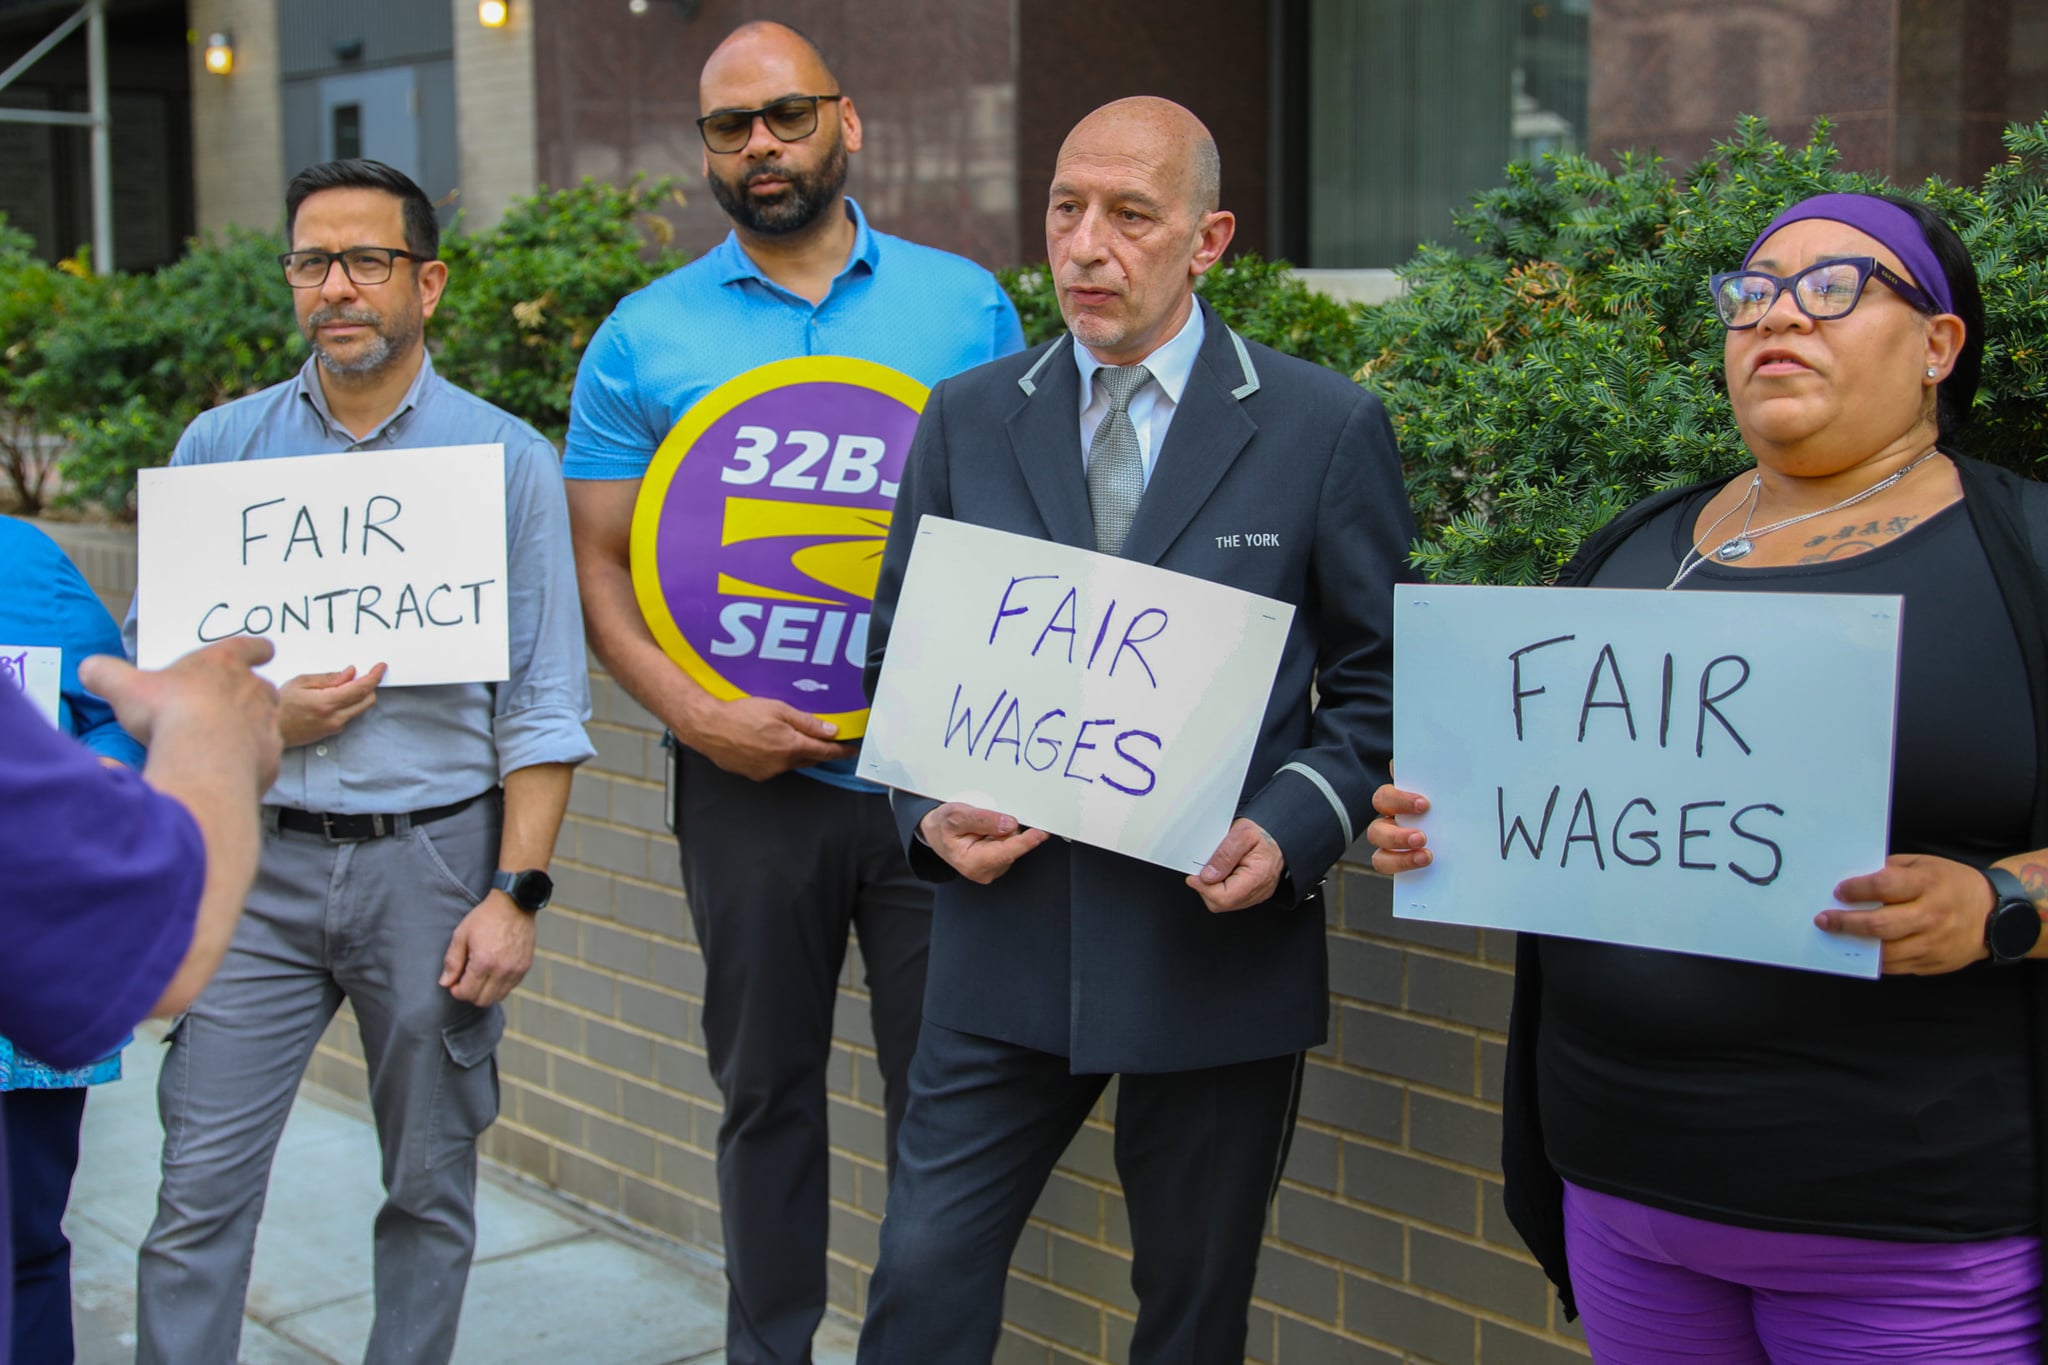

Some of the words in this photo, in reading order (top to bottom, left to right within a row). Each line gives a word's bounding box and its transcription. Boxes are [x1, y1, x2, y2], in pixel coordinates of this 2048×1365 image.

[241, 495, 405, 565] FAIR
[1215, 534, 1241, 549] THE
[1244, 533, 1280, 547] YORK
[198, 579, 496, 642] CONTRACT
[989, 575, 1169, 688] FAIR
[944, 683, 1163, 798] WAGES
[1508, 634, 1752, 758] FAIR
[1497, 785, 1785, 886] WAGES
